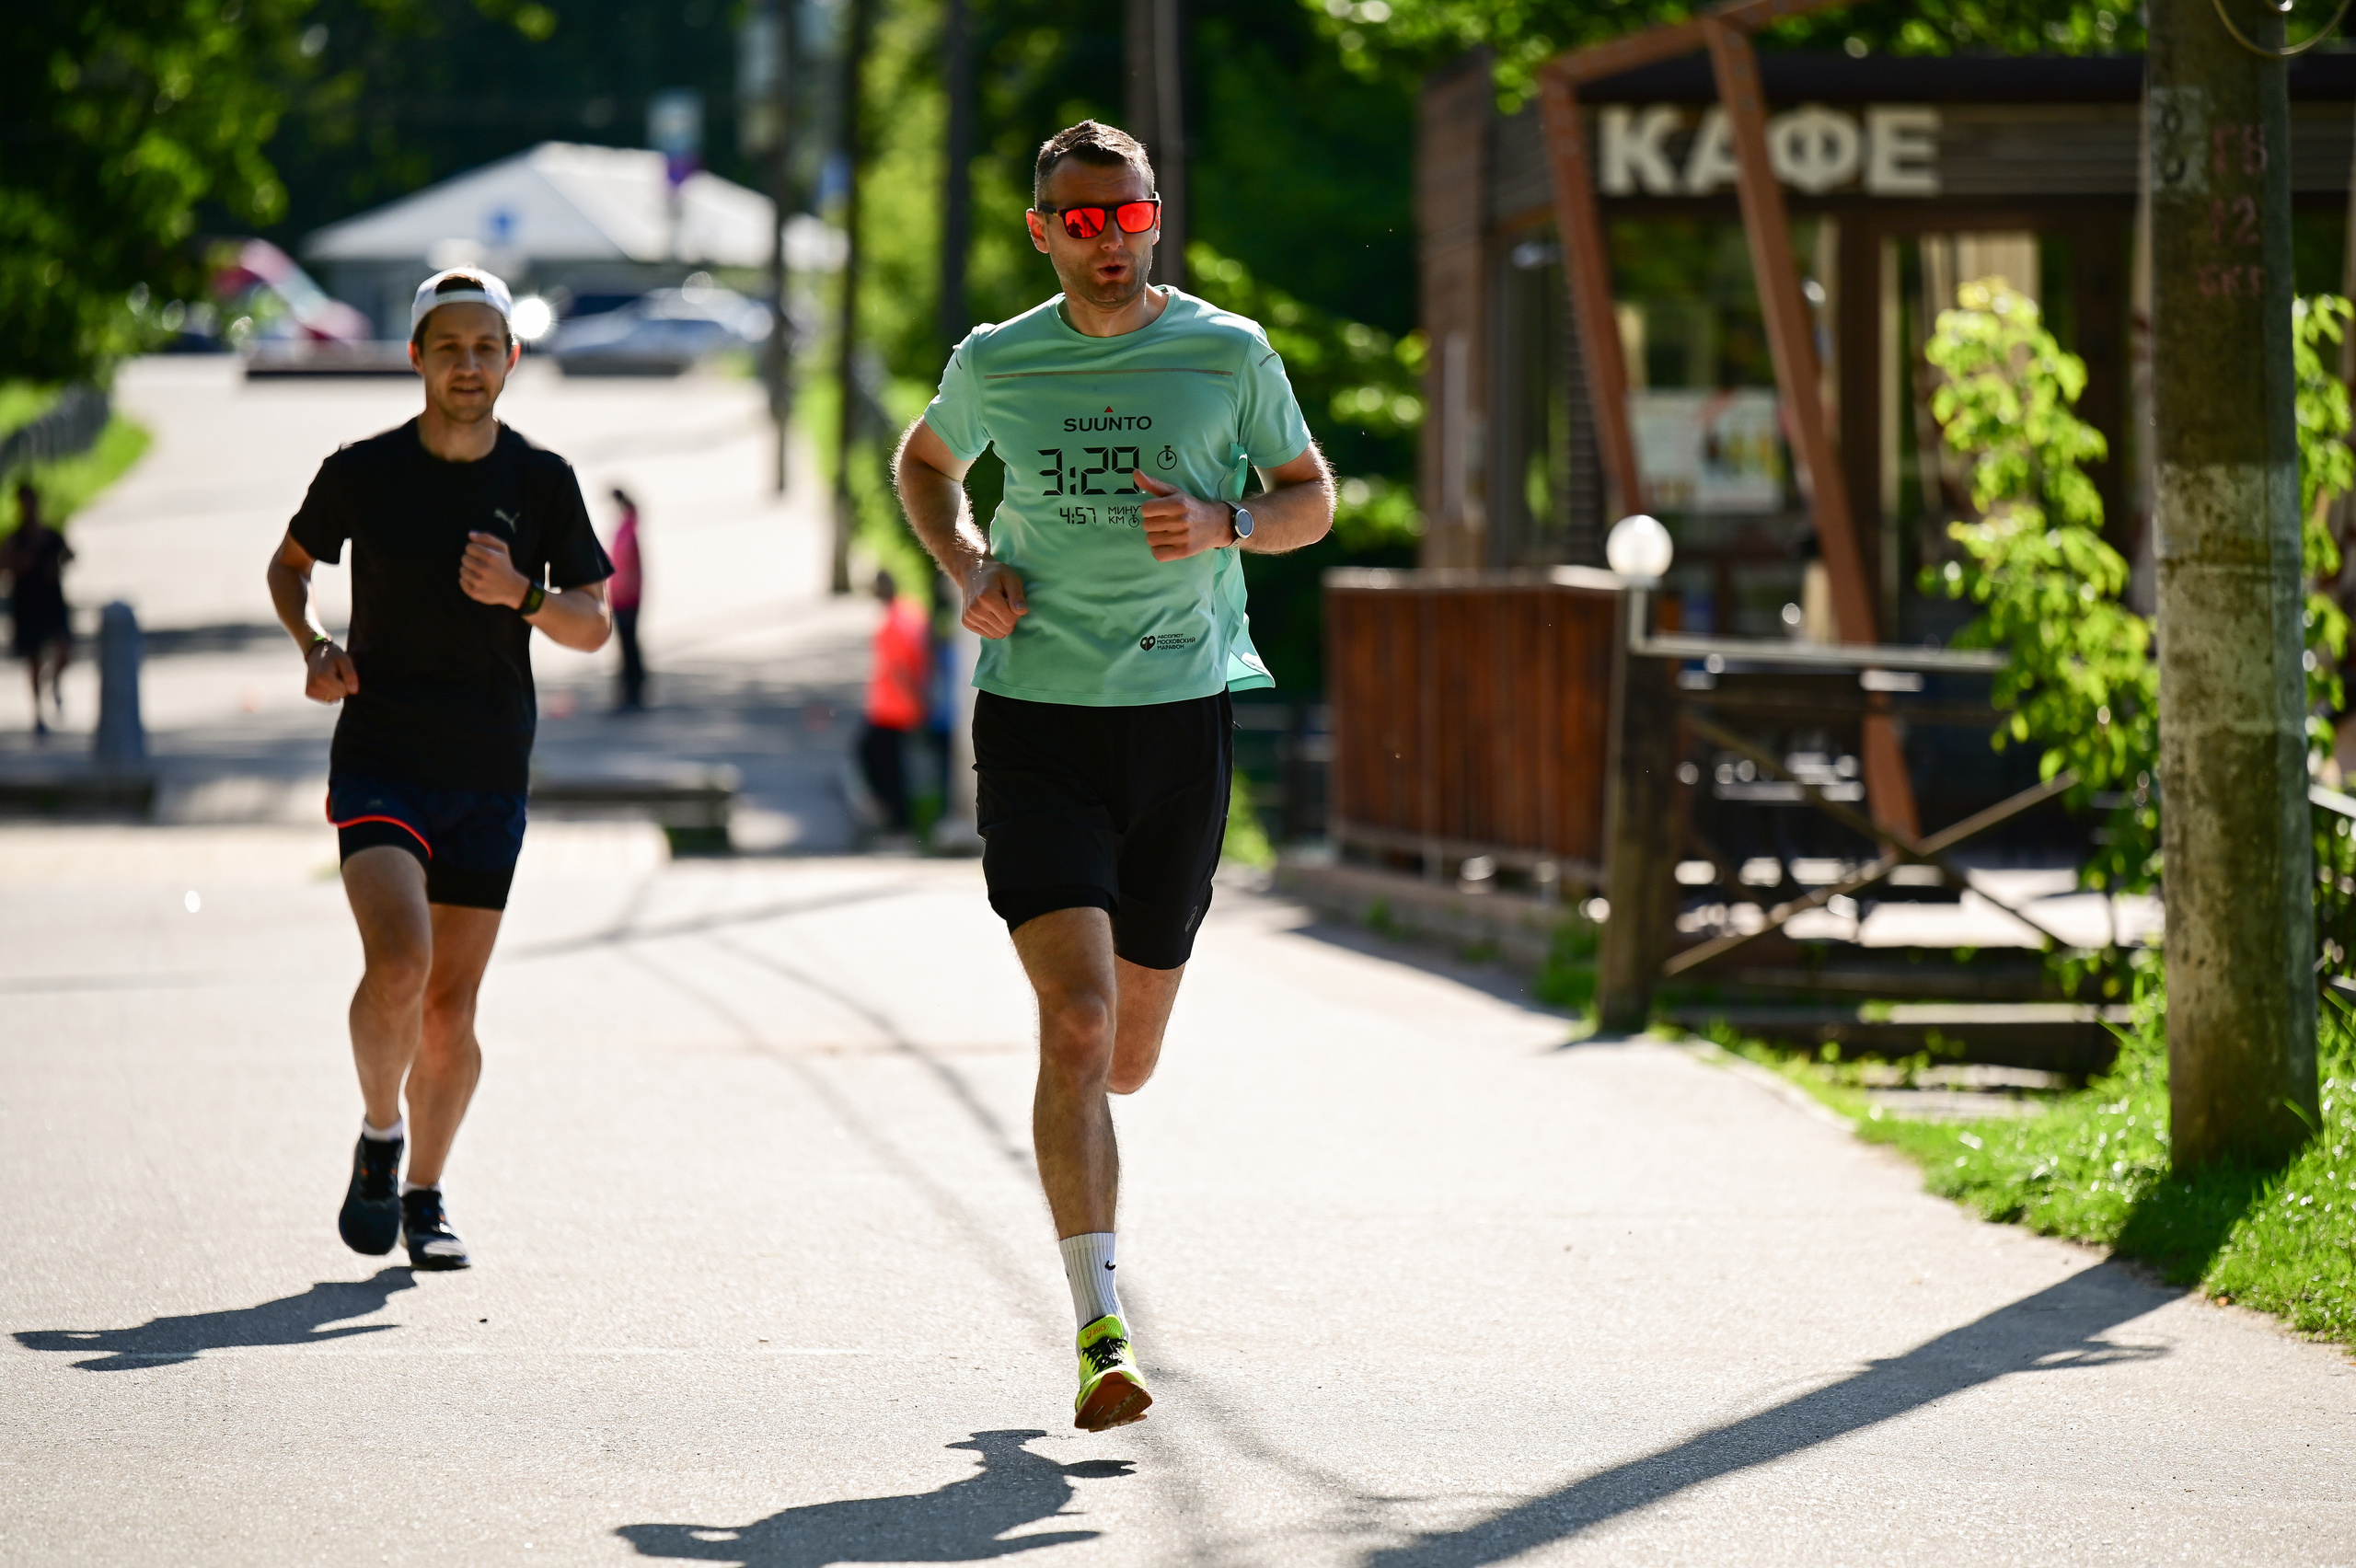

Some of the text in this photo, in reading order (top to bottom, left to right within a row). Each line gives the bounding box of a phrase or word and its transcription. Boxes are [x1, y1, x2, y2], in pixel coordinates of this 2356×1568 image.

[1600, 103, 1942, 195] КАФЕ
[1063, 415, 1152, 432] SUUNTO
[1037, 445, 1140, 496] 3:29
[1059, 506, 1097, 525] 4:57
[1108, 515, 1125, 525] КМ
